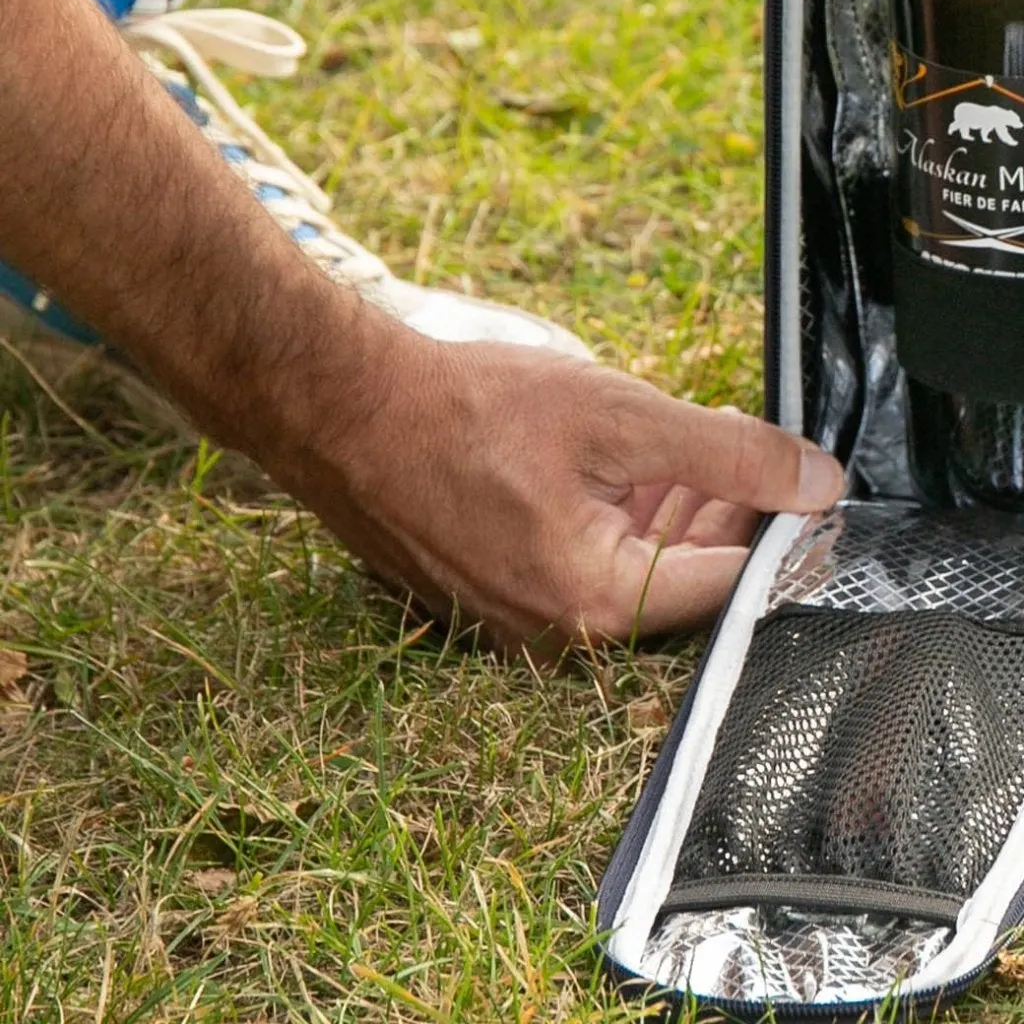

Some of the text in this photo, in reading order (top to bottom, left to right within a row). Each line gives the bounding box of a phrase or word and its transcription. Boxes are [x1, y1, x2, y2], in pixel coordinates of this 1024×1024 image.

[896, 128, 989, 188] Alaskan
[942, 188, 973, 207] FIER
[977, 197, 997, 211] DE
